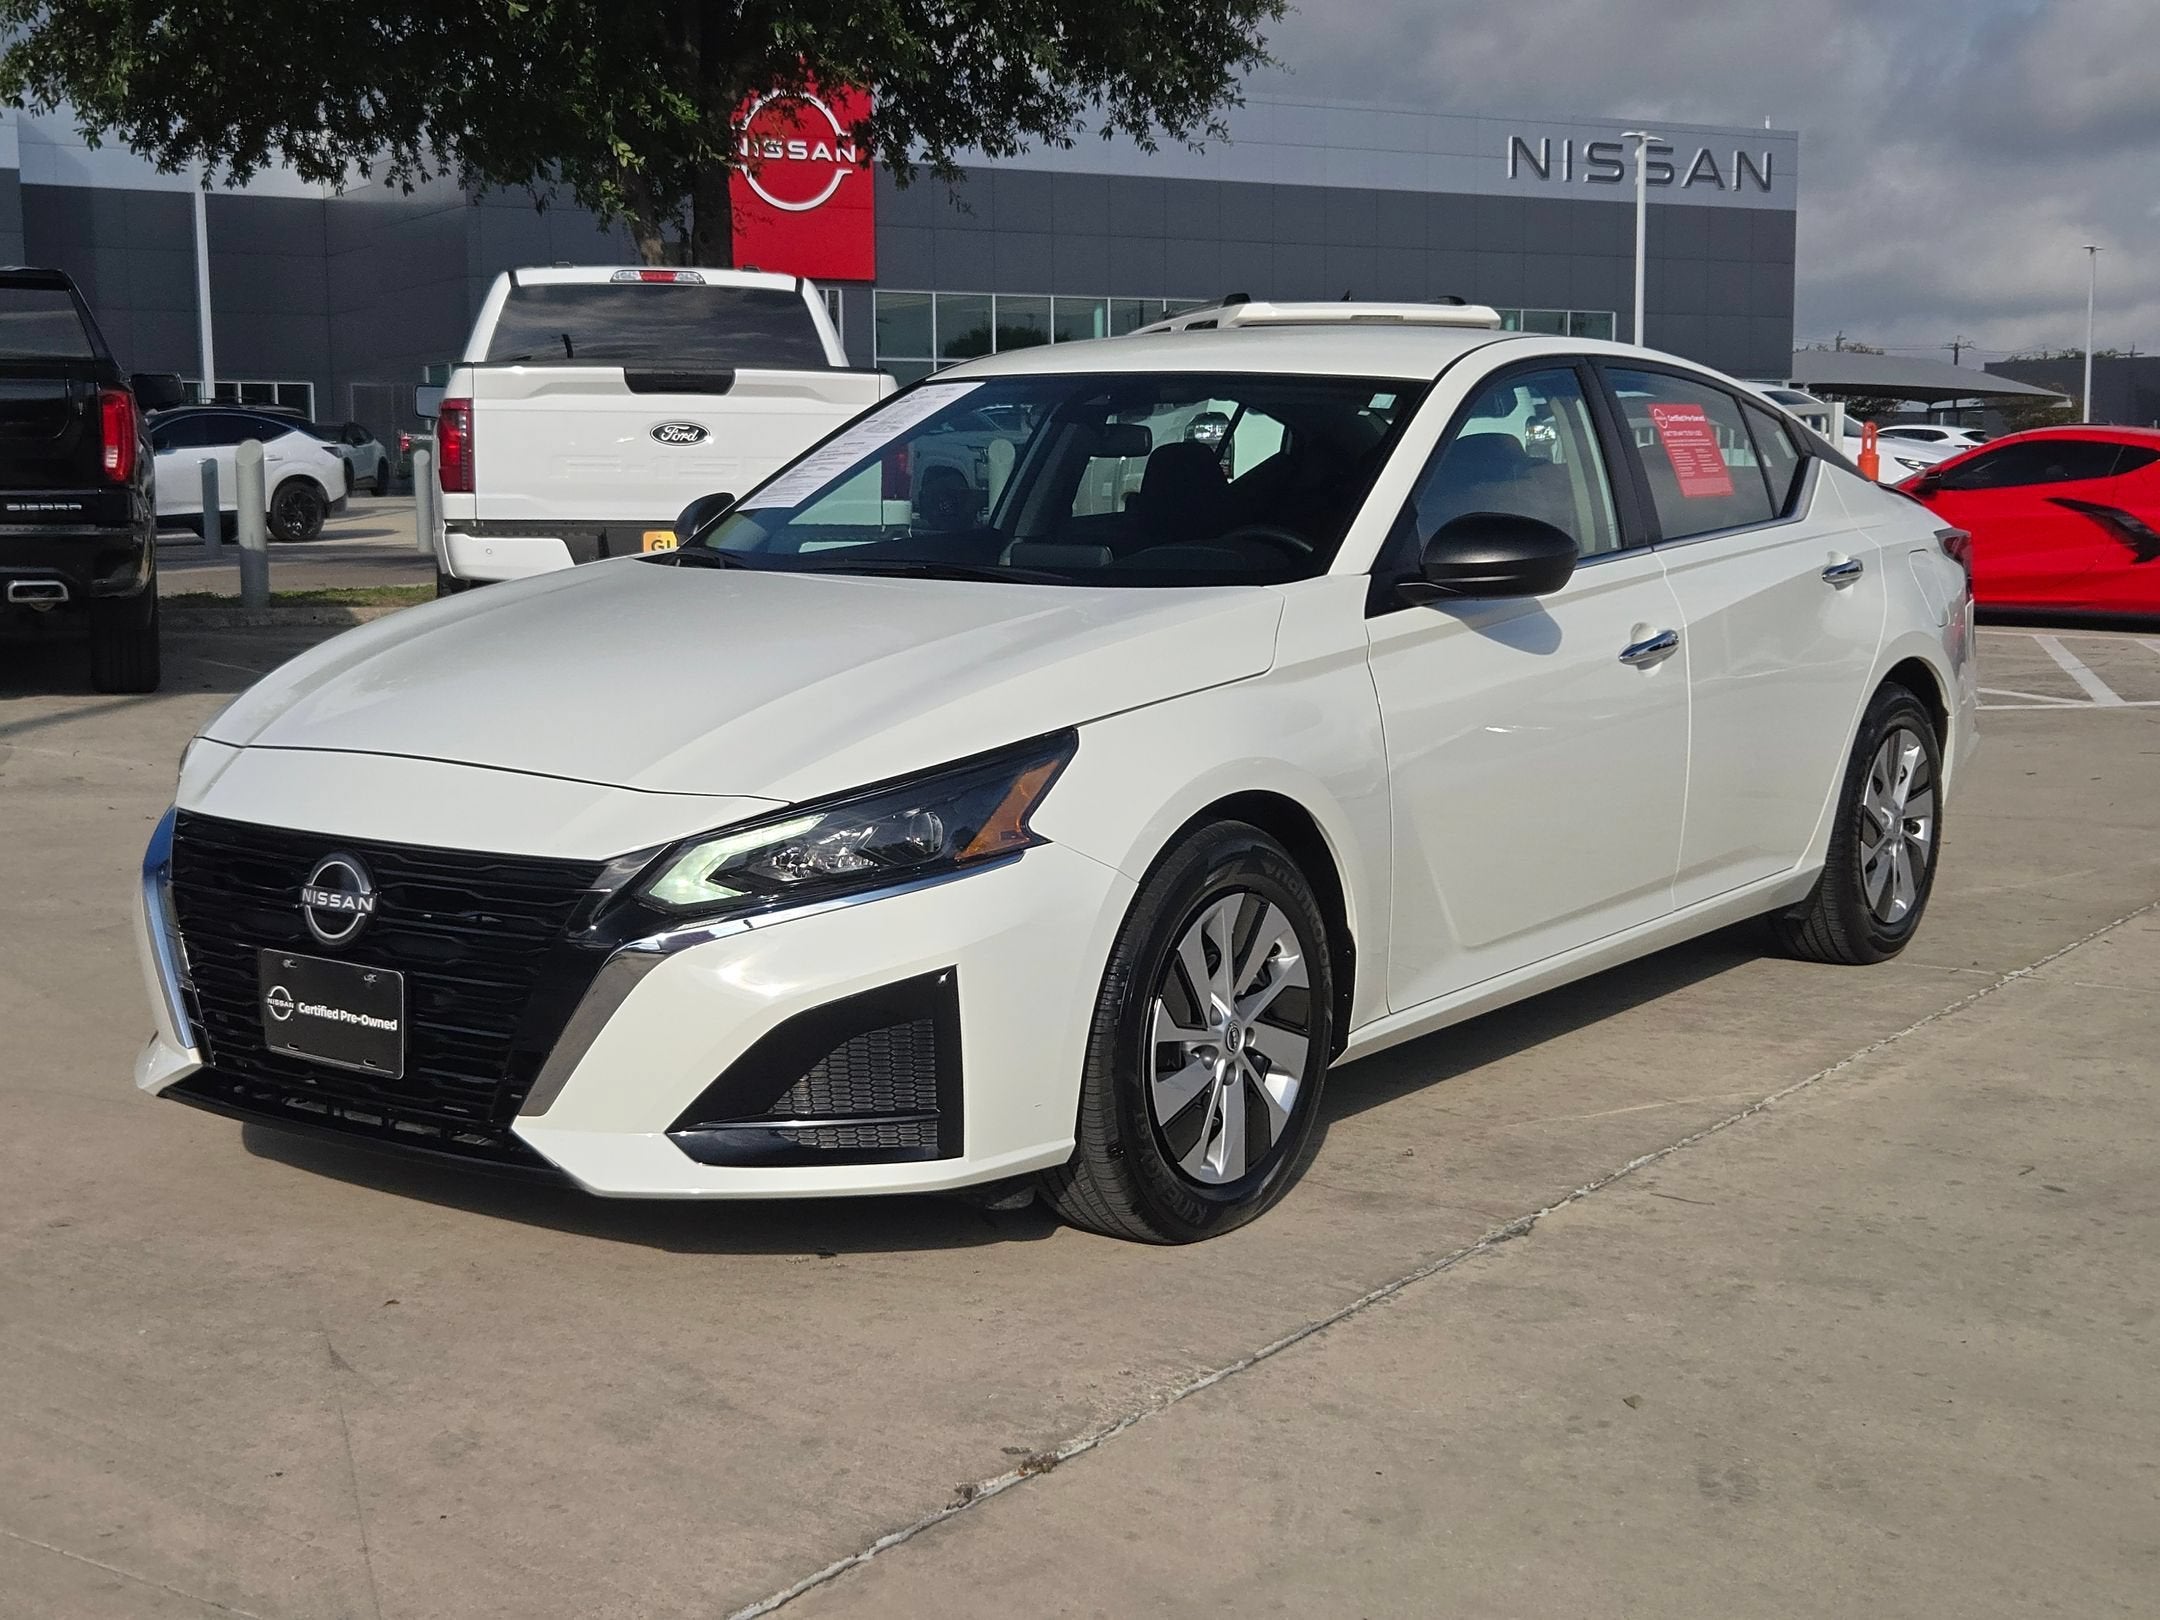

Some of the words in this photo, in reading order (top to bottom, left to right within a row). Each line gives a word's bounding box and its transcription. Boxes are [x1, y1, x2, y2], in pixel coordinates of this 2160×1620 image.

[1507, 135, 1773, 193] NISSAN
[660, 425, 699, 442] Ford
[302, 887, 374, 912] NISSAN
[267, 997, 294, 1009] NISSAN
[298, 1002, 339, 1020] Certified
[340, 1010, 398, 1031] Pre-Owned
